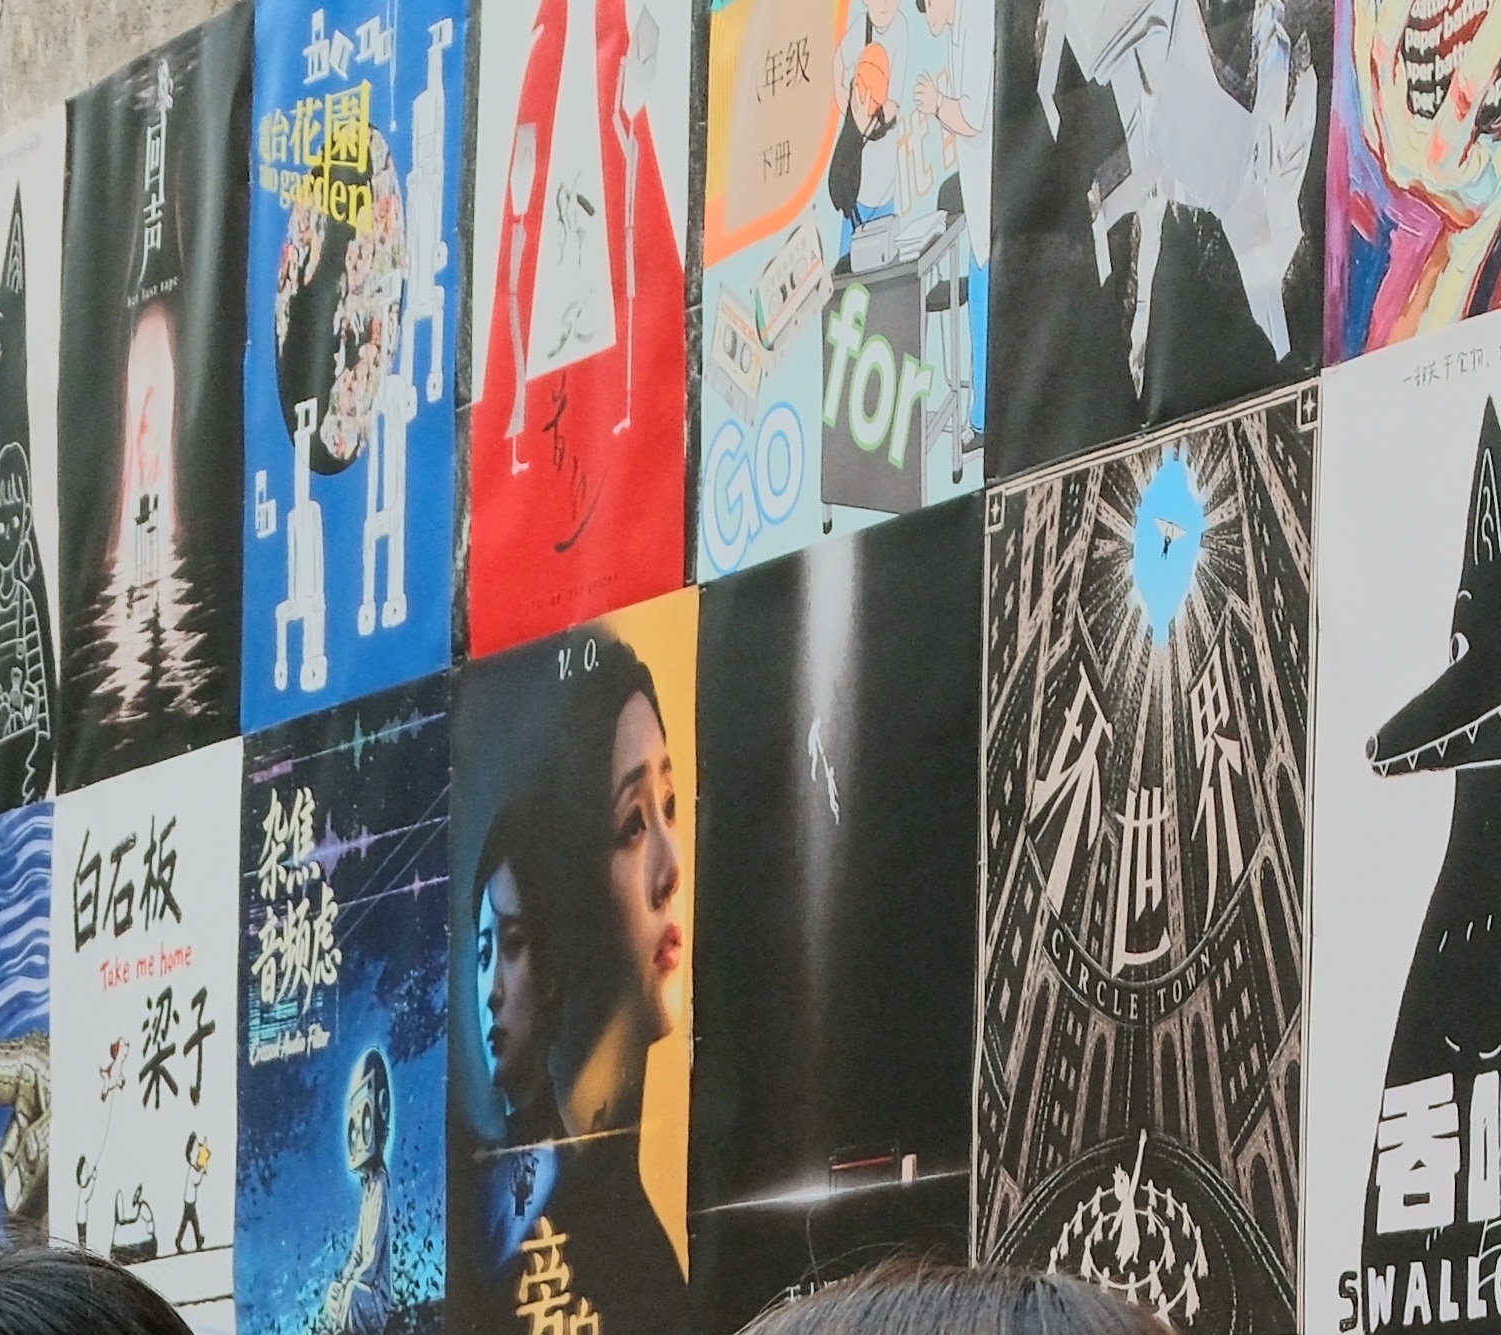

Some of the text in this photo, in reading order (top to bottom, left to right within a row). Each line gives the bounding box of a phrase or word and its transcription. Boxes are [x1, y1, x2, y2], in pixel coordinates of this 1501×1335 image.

[280, 170, 373, 236] garden
[758, 140, 792, 183] 下册
[702, 400, 804, 573] GO
[822, 282, 933, 468] for
[73, 814, 182, 952] 白石板
[100, 942, 192, 991] Take me home
[1051, 928, 1213, 1021] CIRCLE TOWN
[139, 985, 215, 1110] 梁子
